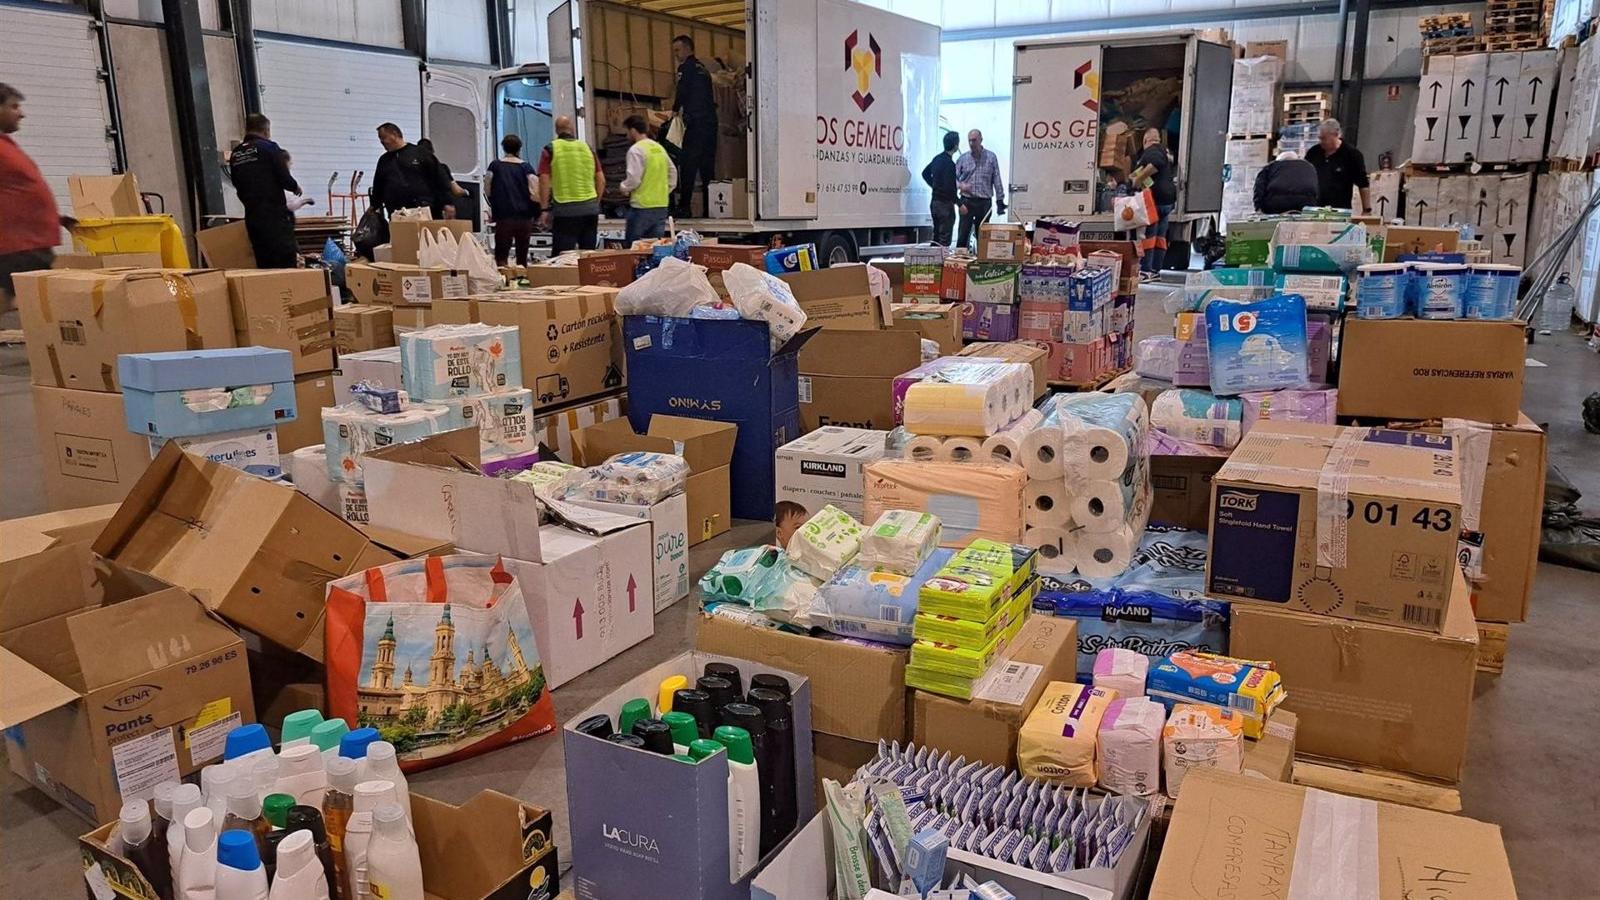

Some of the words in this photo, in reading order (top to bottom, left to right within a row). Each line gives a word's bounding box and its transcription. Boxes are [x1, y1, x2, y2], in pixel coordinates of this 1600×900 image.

[817, 116, 838, 145] OS
[844, 120, 905, 151] GEMELO
[1024, 121, 1061, 139] LOS
[1023, 142, 1075, 150] MUDANZAS
[704, 254, 733, 264] Pascual
[590, 263, 617, 273] Pascual
[561, 320, 586, 334] Cartón
[447, 365, 471, 376] ROLLO
[1431, 368, 1485, 378] REFERENCIAS
[1485, 370, 1514, 379] VARIAS
[502, 415, 526, 426] ROLLO
[803, 461, 845, 473] KIRKLAND
[782, 484, 806, 493] diapers
[840, 490, 864, 499] pañale
[1221, 496, 1255, 509] TORK
[1364, 501, 1399, 526] 01
[1412, 507, 1452, 532] 43
[1253, 521, 1271, 529] Hand
[115, 688, 150, 707] TENA
[105, 713, 153, 737] Pants
[1036, 766, 1071, 776] Cotton
[603, 823, 660, 854] LACURA
[850, 845, 862, 873] Brosse
[1216, 815, 1248, 900] COMPRESAS
[1258, 831, 1293, 900] TAMPAX
